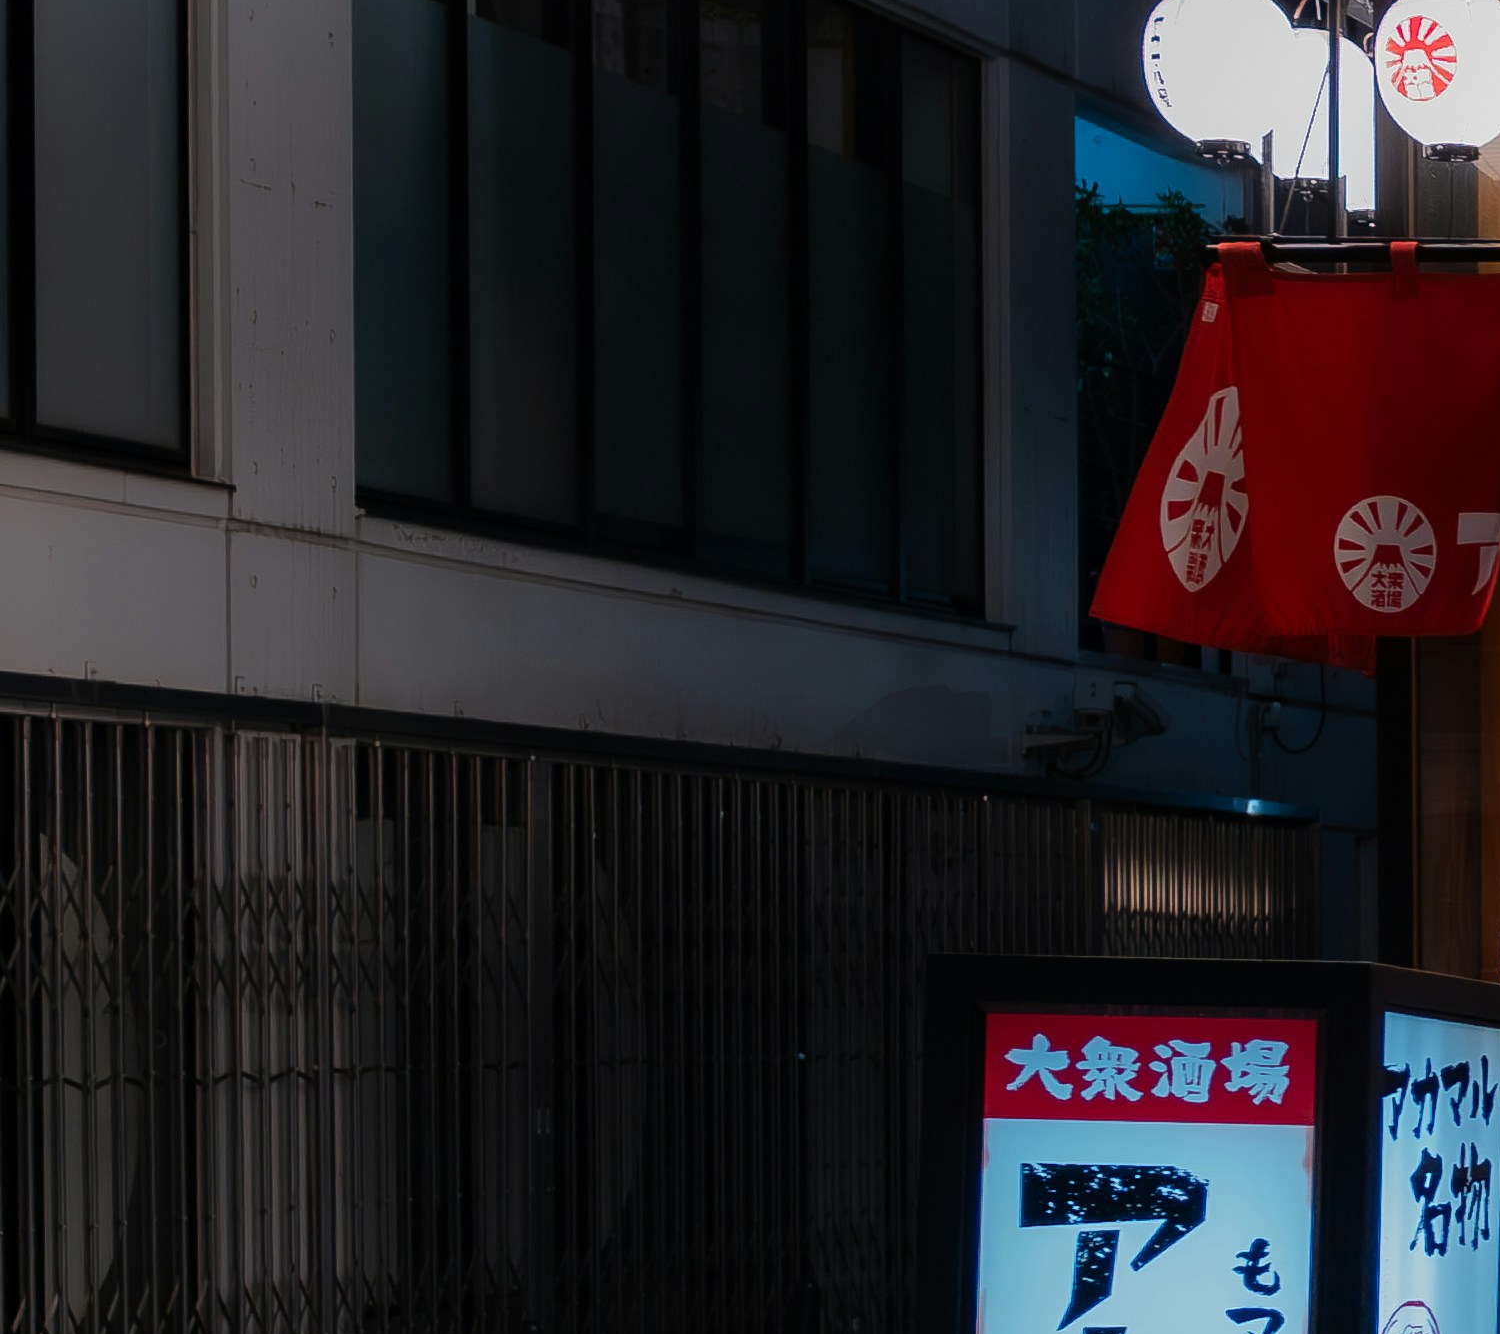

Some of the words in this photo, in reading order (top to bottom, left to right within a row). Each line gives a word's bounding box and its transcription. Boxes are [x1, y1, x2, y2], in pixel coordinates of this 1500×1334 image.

[1004, 1033, 1292, 1106] 大衆酒場
[1381, 1053, 1499, 1141] アカマル
[1408, 1141, 1494, 1258] 名物
